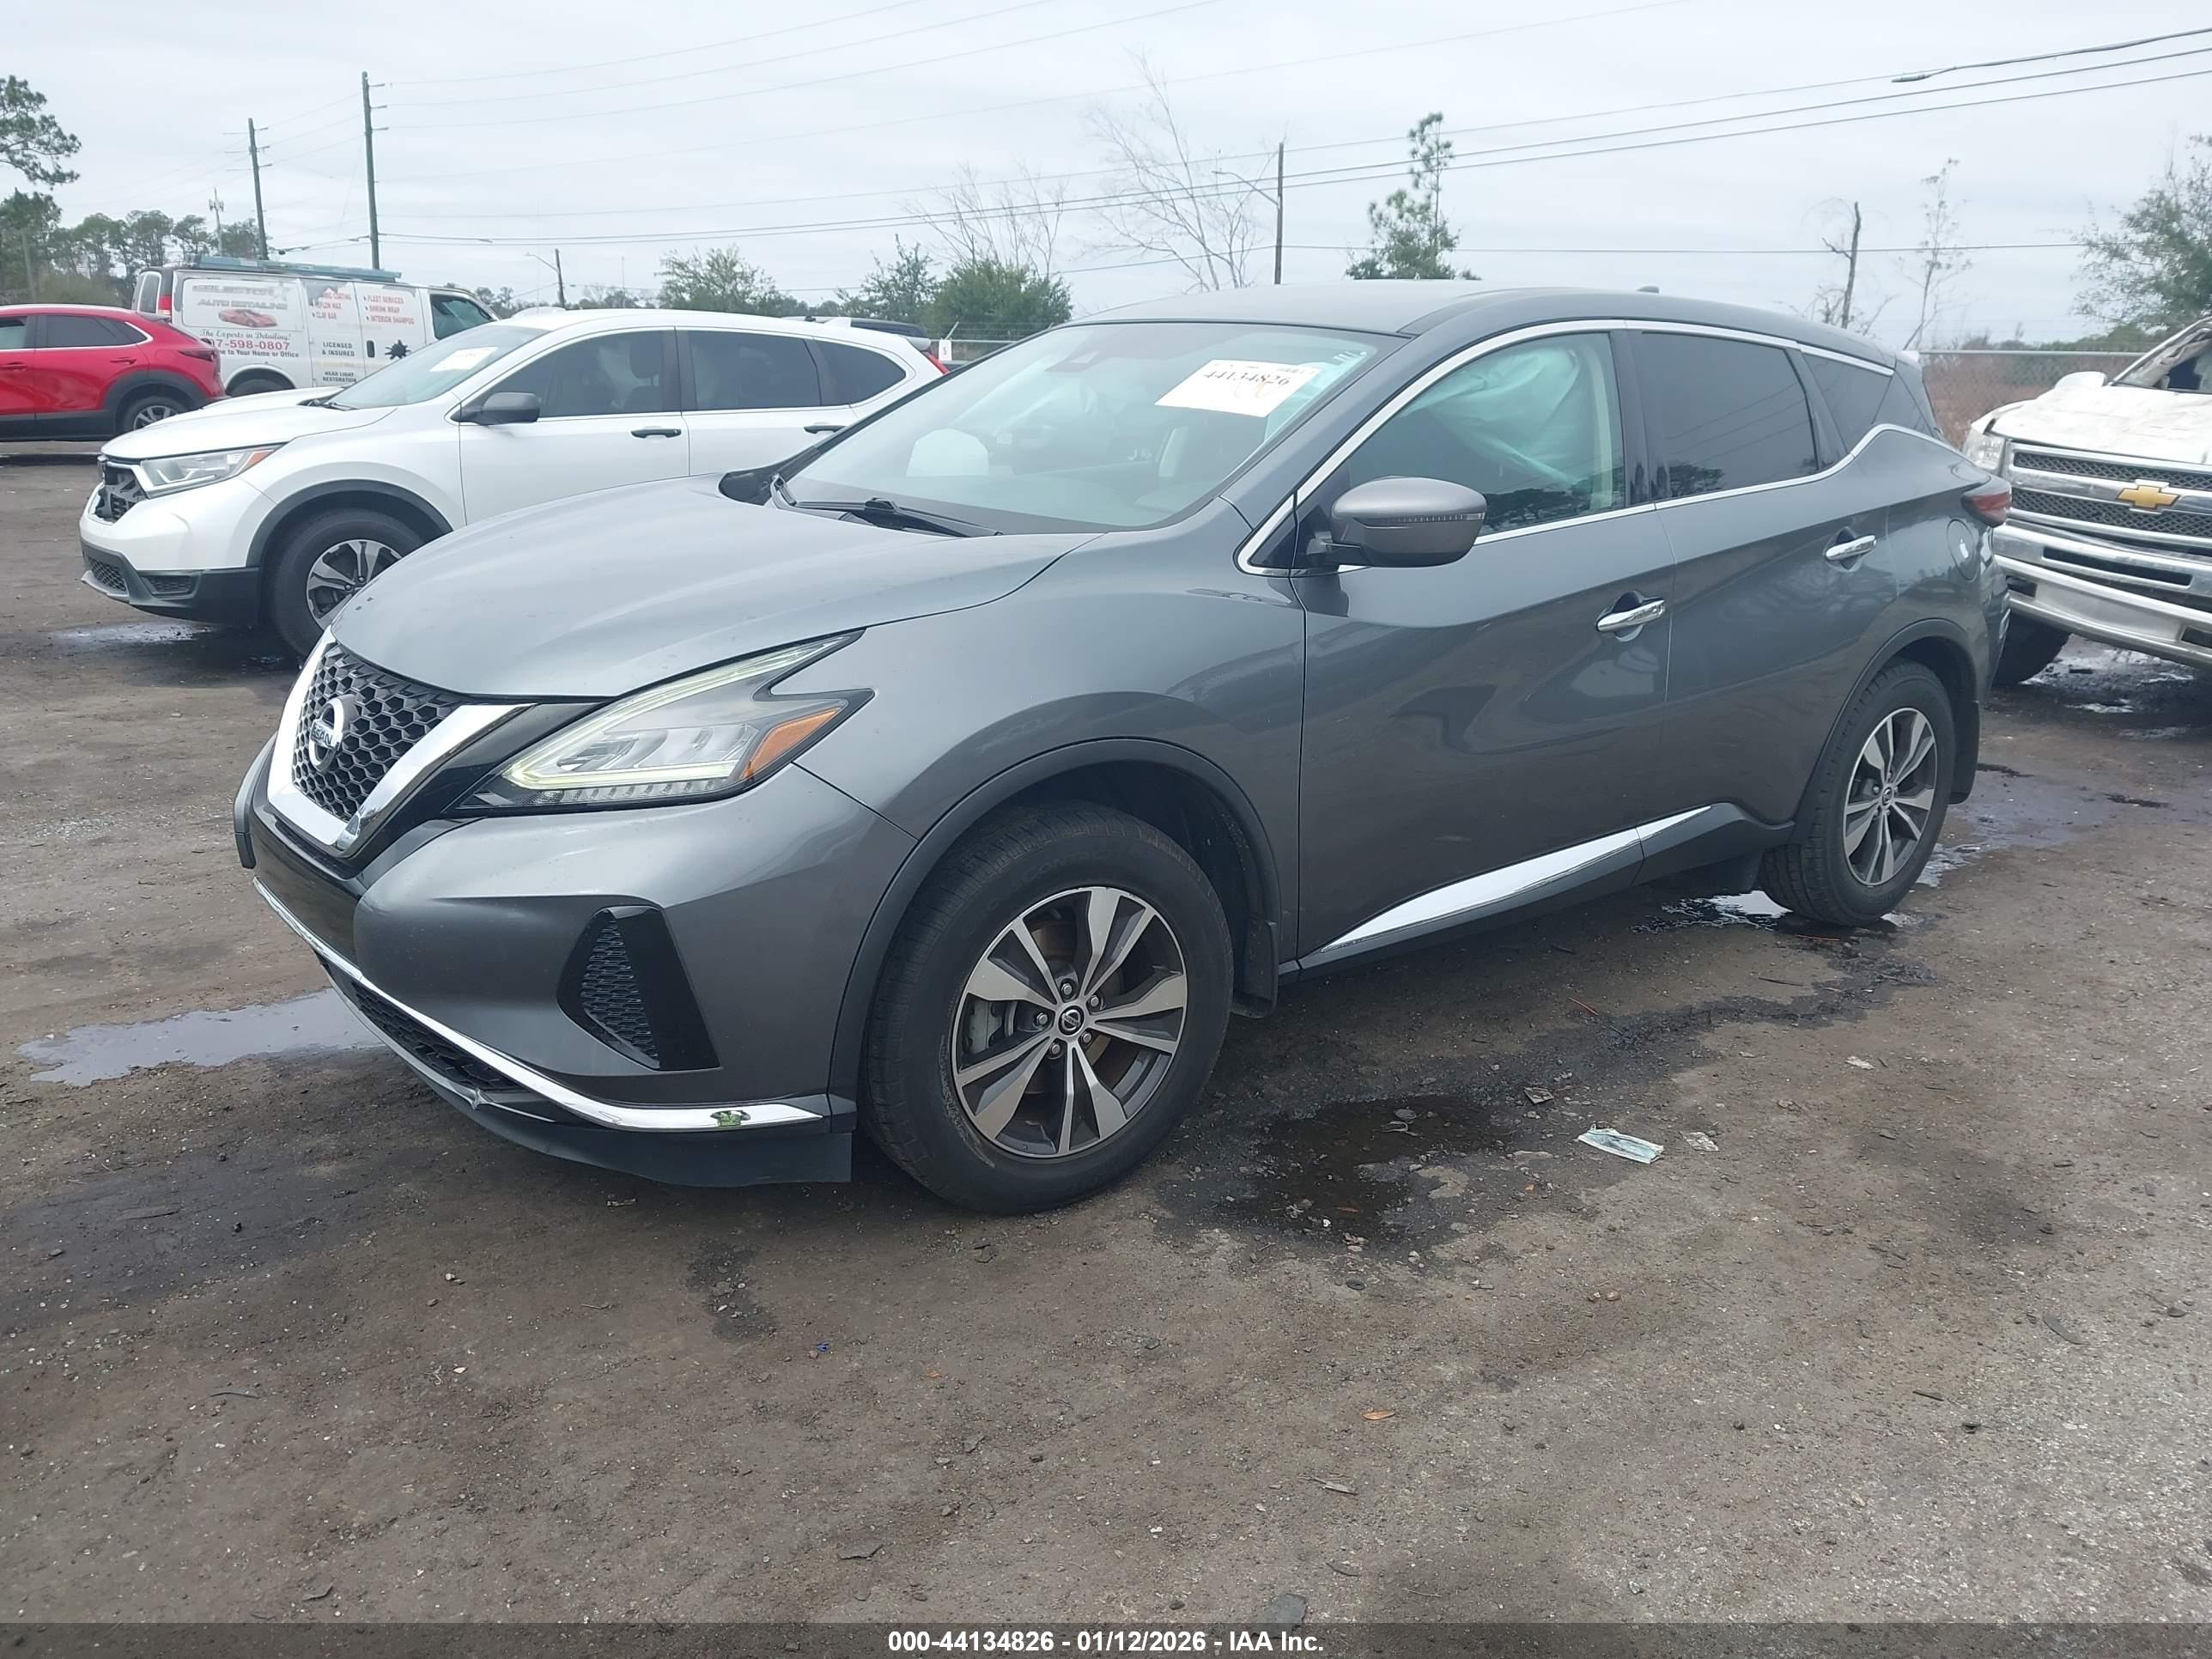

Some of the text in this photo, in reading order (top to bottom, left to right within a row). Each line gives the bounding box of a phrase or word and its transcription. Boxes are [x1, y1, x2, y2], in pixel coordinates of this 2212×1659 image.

[197, 299, 229, 307] AUTO
[368, 295, 404, 305] FLEET SERVICES
[371, 314, 392, 323] INTERIOR
[200, 329, 213, 337] The
